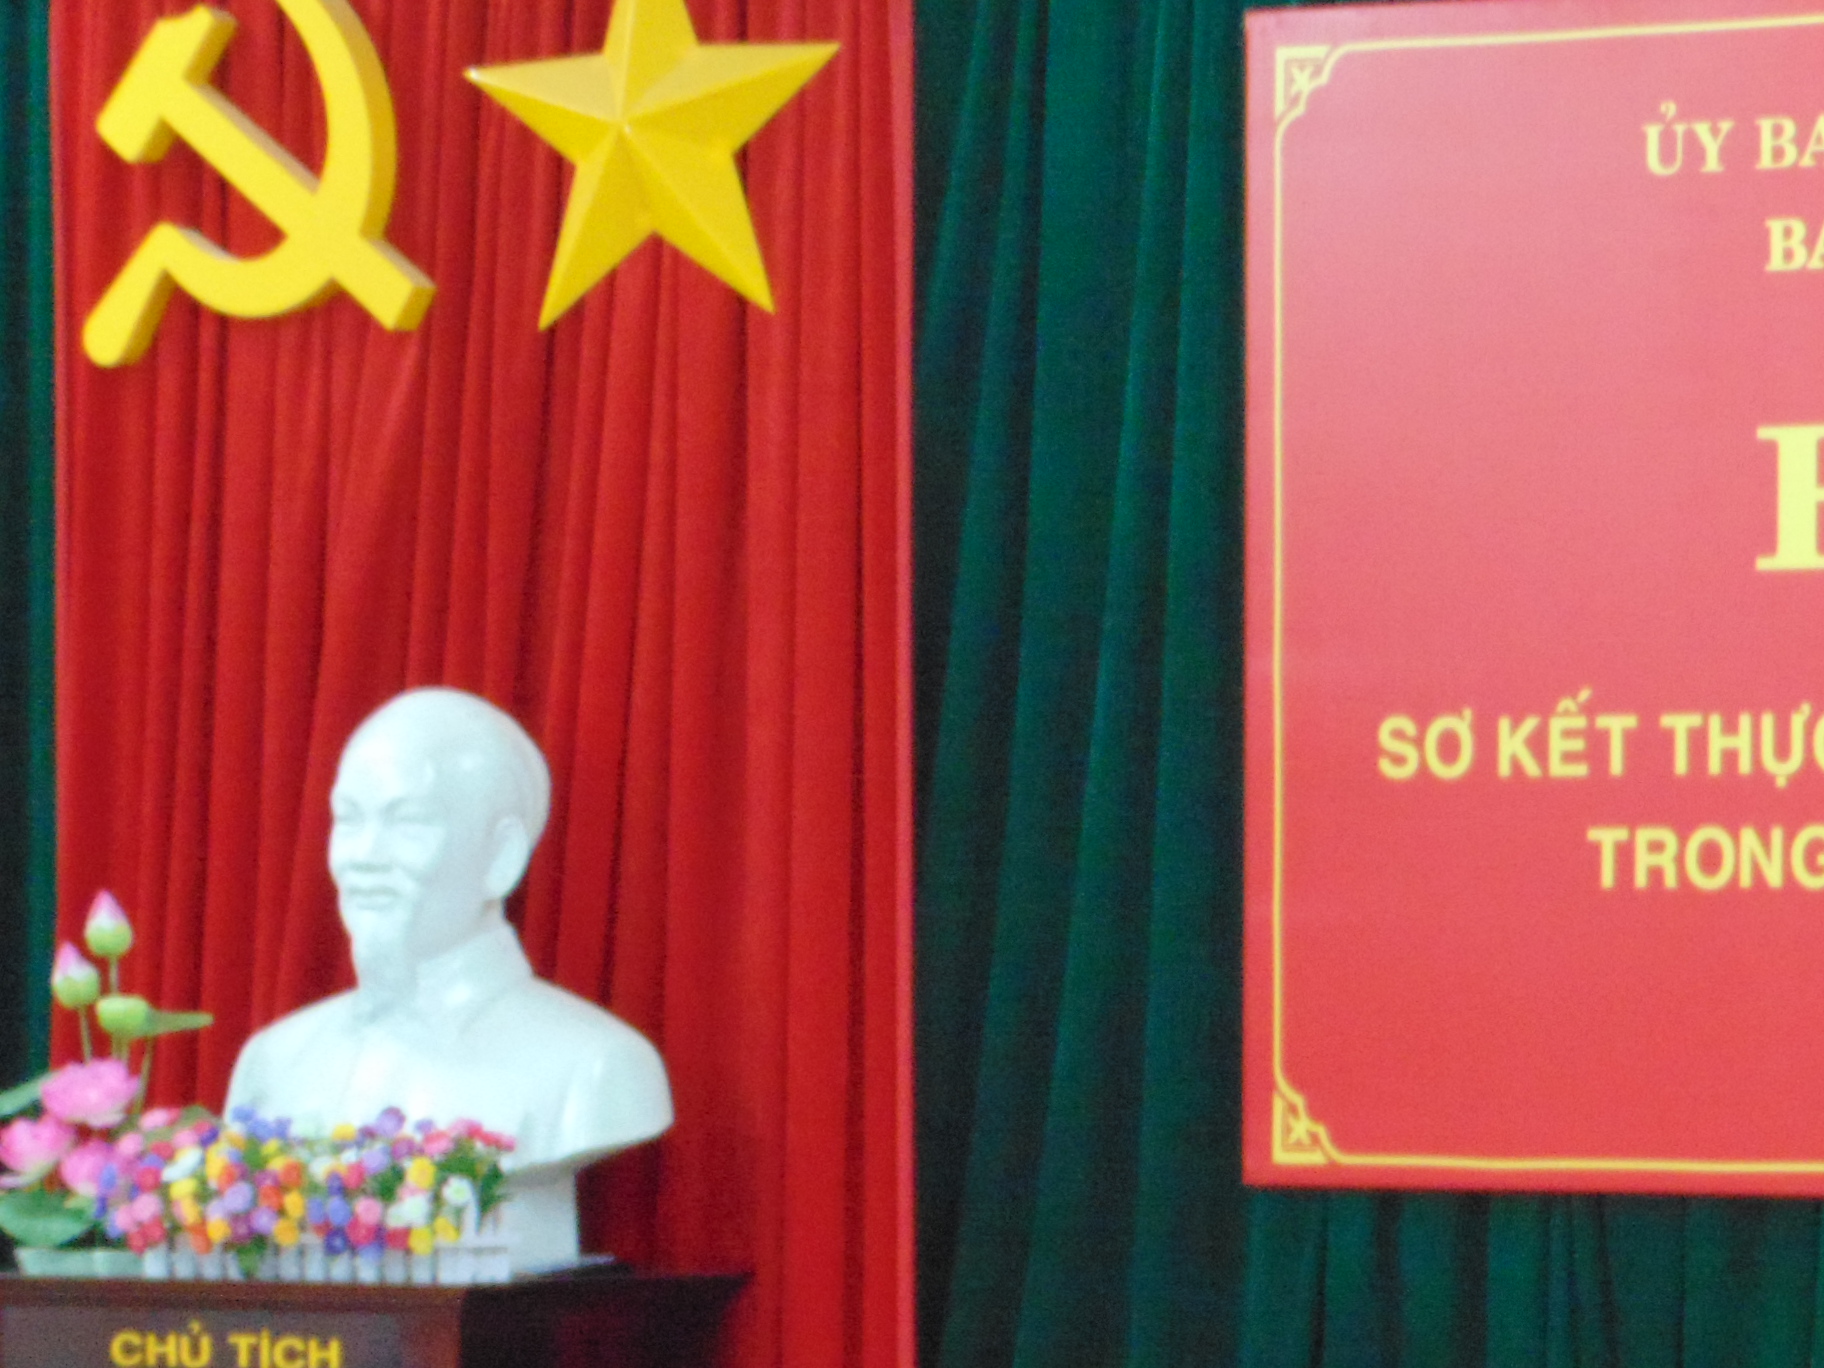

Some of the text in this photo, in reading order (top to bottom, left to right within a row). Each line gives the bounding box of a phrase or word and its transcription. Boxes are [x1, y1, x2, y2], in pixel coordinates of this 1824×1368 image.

[1646, 103, 1733, 174] ỦY
[1378, 709, 1474, 781] SƠ
[1497, 688, 1639, 779] KẾT
[110, 1318, 212, 1368] CHỦ
